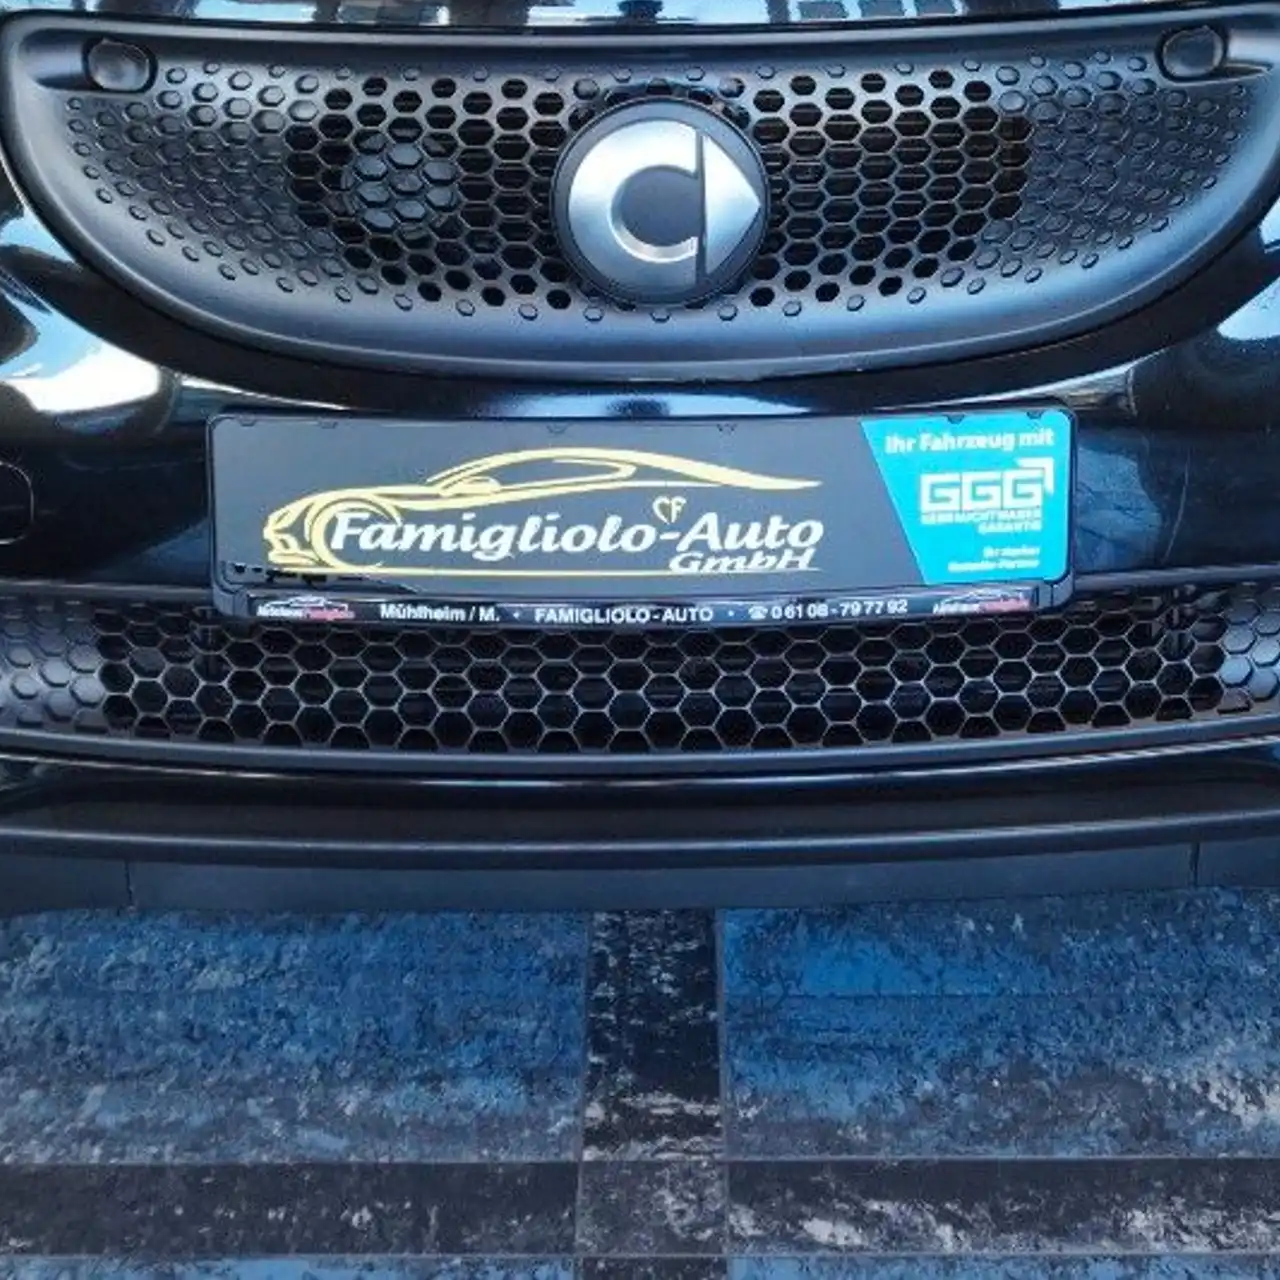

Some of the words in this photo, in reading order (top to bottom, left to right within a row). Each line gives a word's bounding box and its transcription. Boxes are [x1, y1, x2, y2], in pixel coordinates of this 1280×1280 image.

[919, 431, 1016, 452] Fahrzeug
[1019, 427, 1056, 447] mit
[920, 468, 1044, 513] GGG
[330, 511, 825, 563] Famigliolo-Auto
[669, 547, 817, 573] GmbH
